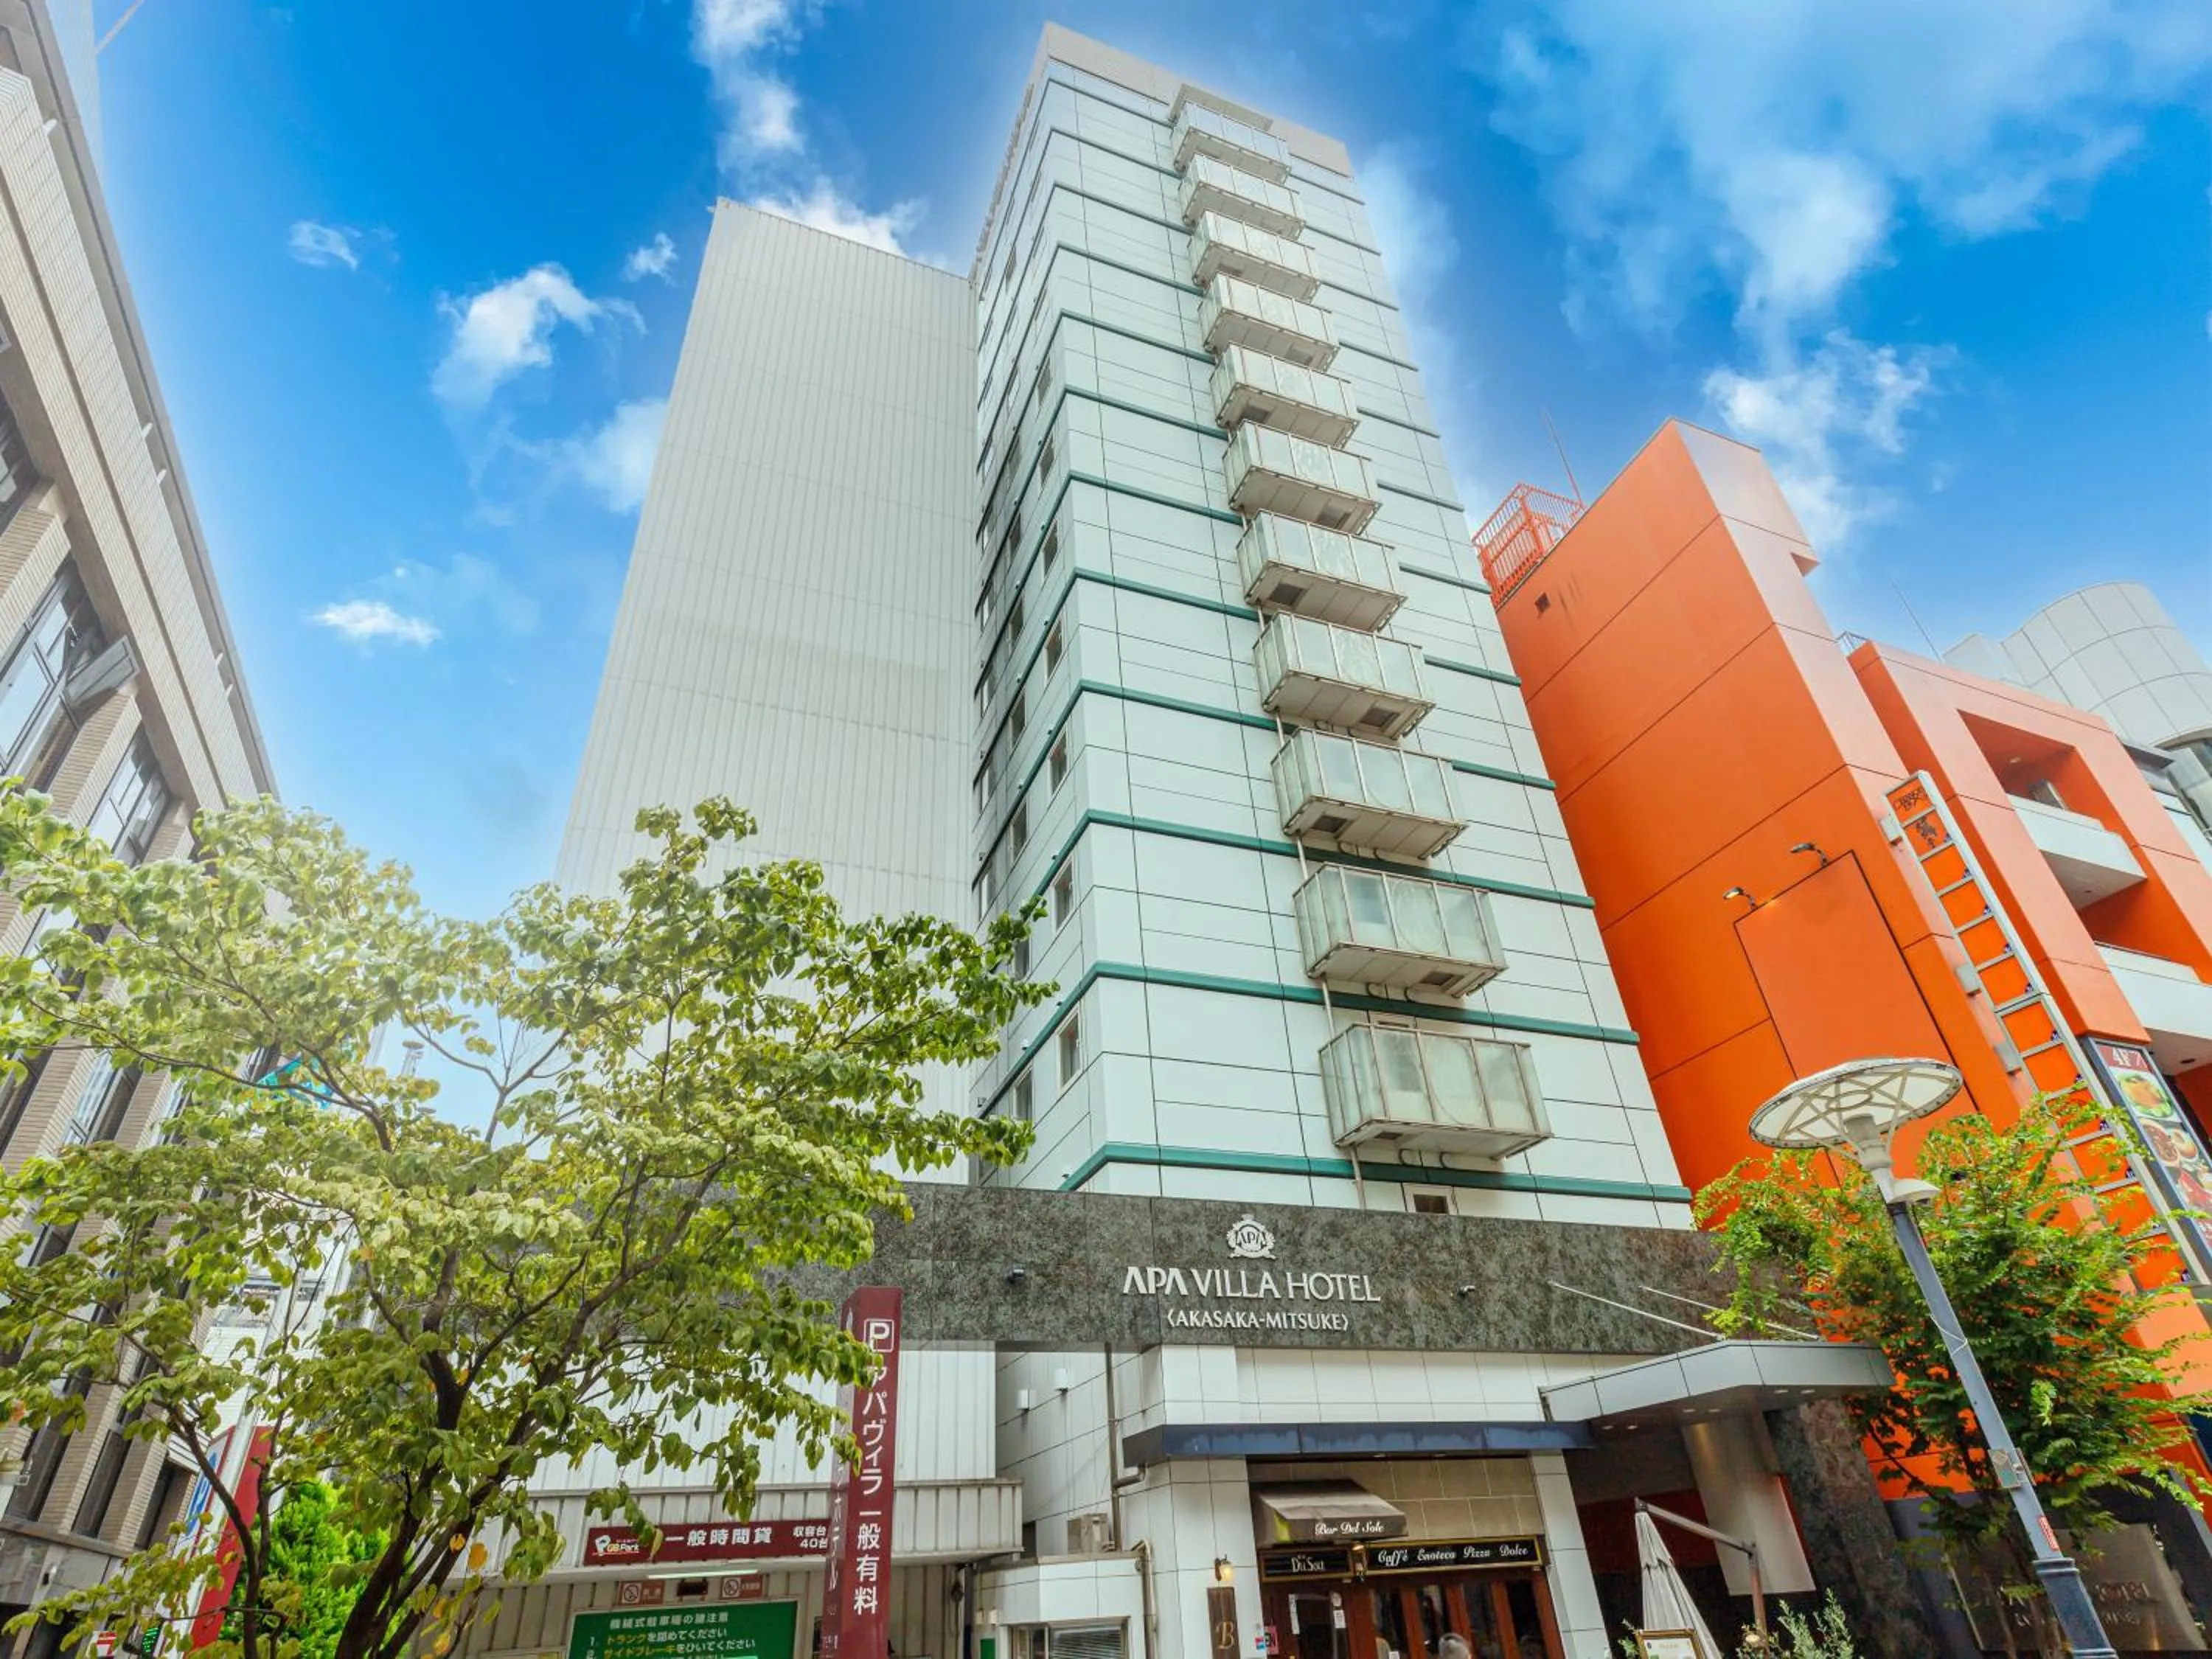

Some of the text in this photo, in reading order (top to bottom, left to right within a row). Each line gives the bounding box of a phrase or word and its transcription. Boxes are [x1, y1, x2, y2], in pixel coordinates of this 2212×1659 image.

[1123, 1266, 1381, 1301] APA VILLA HOTEL
[869, 1322, 890, 1351] P
[853, 1510, 883, 1616] 一般有料
[1216, 1621, 1235, 1649] B
